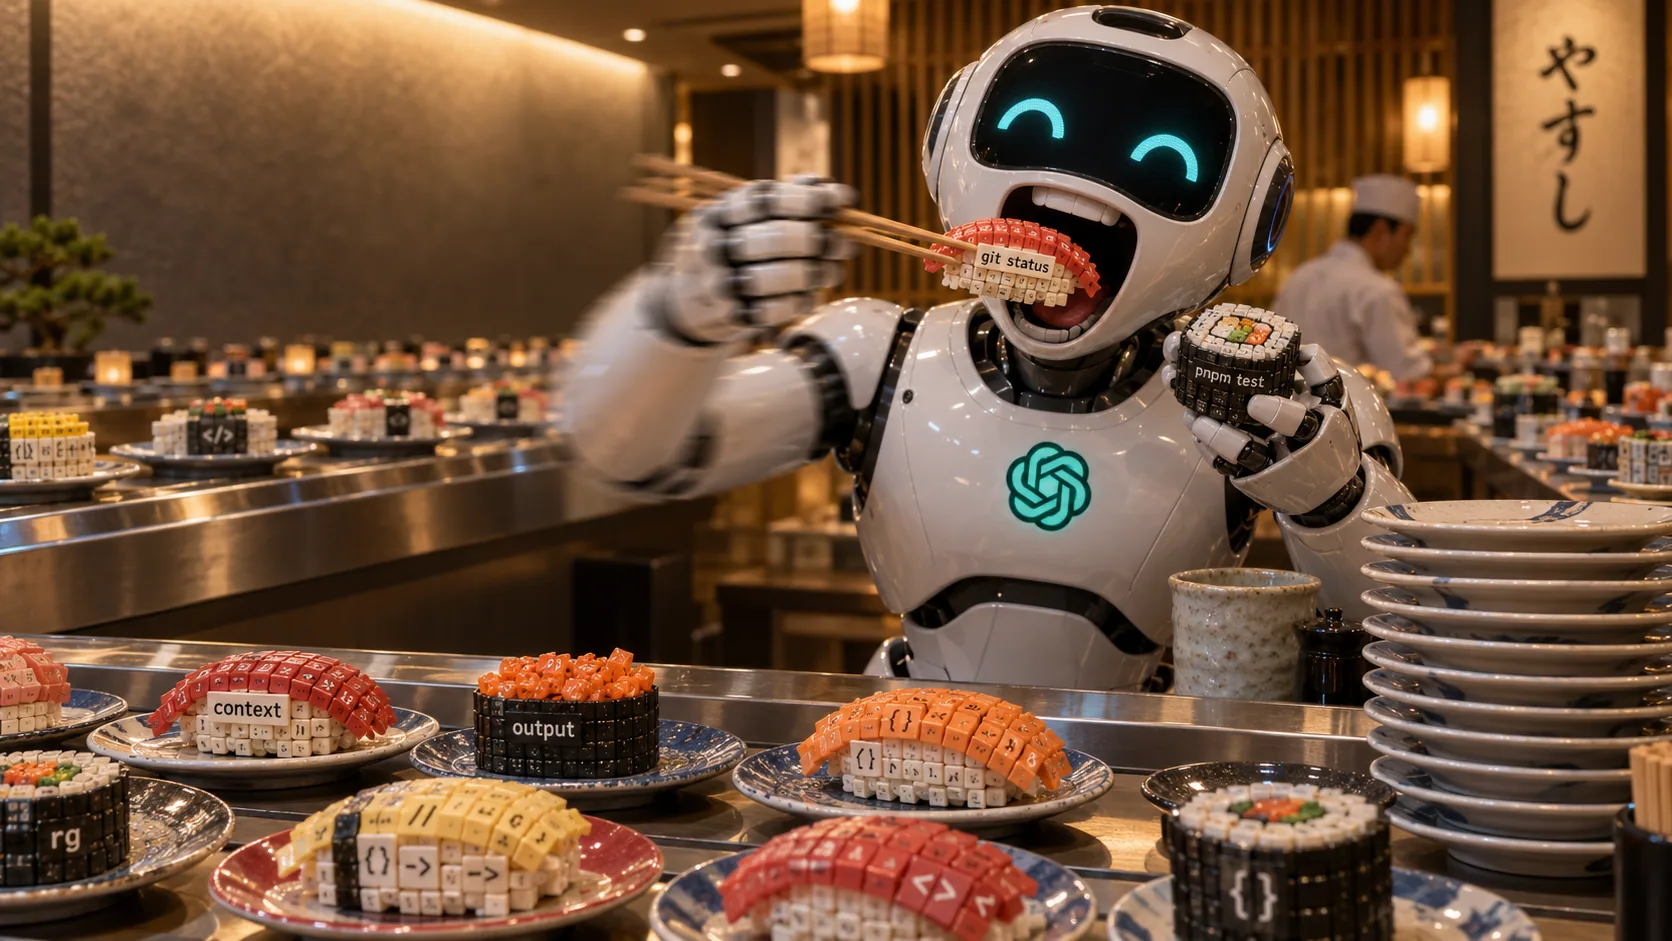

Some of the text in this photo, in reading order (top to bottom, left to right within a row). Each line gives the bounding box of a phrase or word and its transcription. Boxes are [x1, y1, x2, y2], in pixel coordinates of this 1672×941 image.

[1539, 36, 1597, 234] やすし
[981, 251, 1049, 273] git status
[1195, 366, 1265, 388] pnpm test
[213, 700, 282, 719] context
[889, 708, 912, 733] {}
[512, 720, 575, 741] output
[51, 827, 81, 853] rg
[365, 845, 391, 876] {}
[1229, 869, 1278, 923] {}
